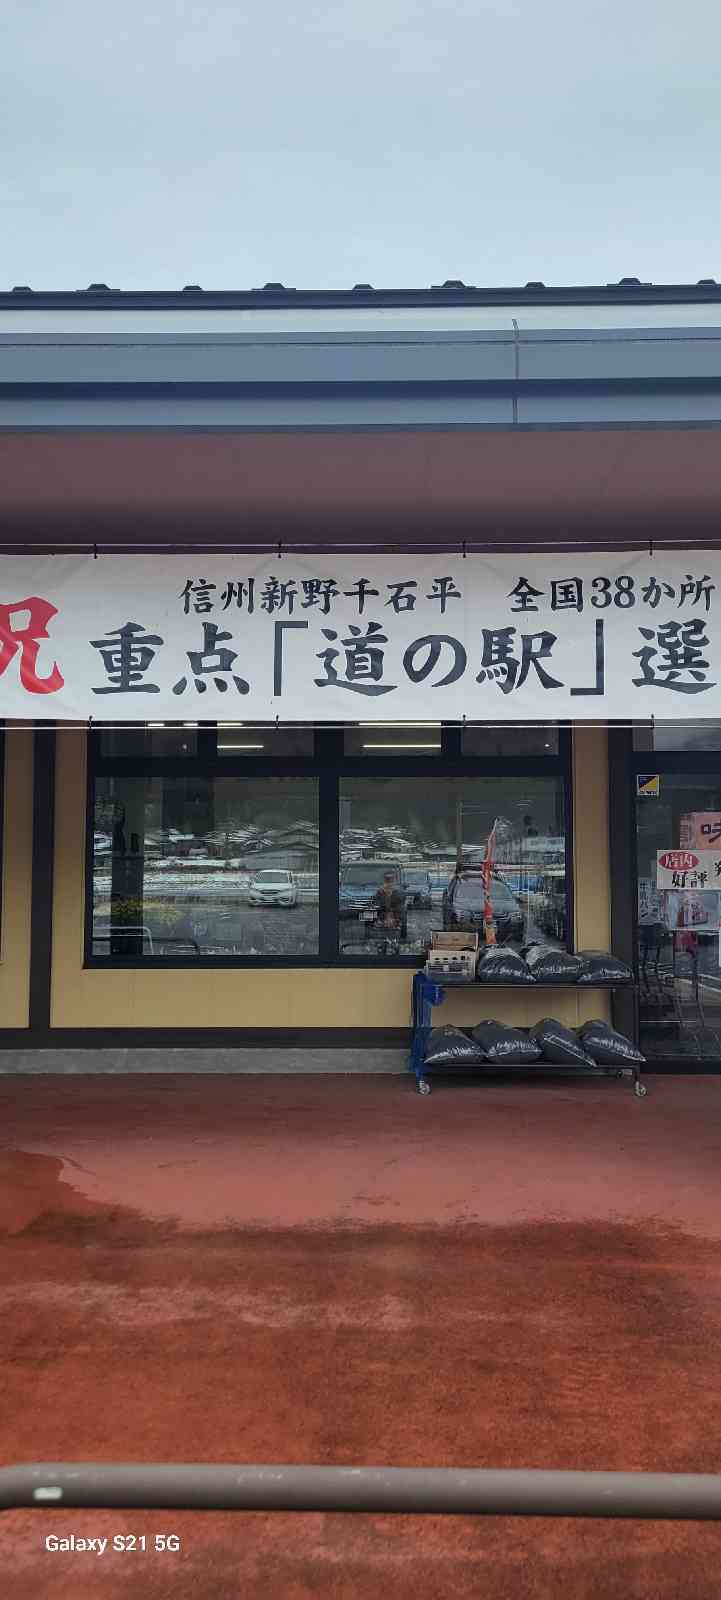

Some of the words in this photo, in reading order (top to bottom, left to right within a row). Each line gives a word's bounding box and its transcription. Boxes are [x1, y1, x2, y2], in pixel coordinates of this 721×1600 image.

[179, 576, 462, 614] 信州新野千石平
[507, 575, 716, 612] 全国38か所
